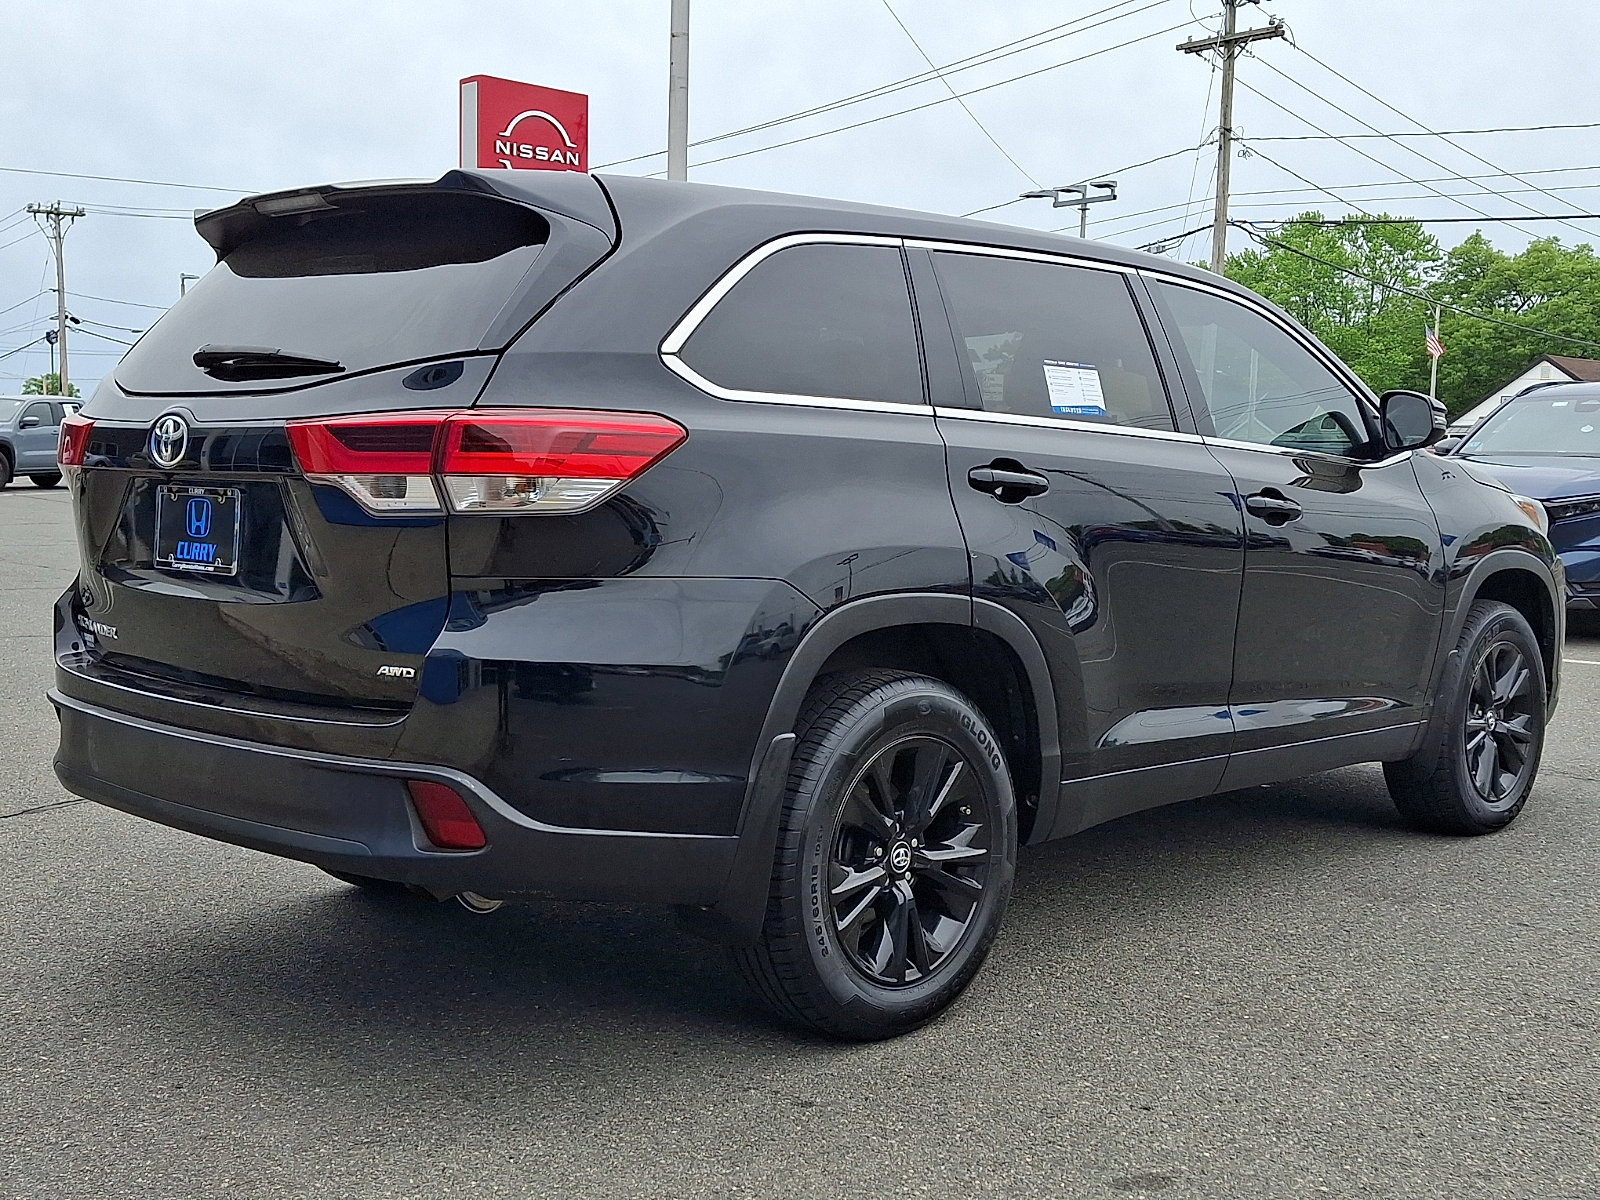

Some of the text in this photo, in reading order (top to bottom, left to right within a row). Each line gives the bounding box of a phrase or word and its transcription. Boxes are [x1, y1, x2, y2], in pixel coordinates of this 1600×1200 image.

[495, 140, 579, 166] NISSAN
[176, 541, 217, 562] CURRY
[376, 665, 415, 678] AWD
